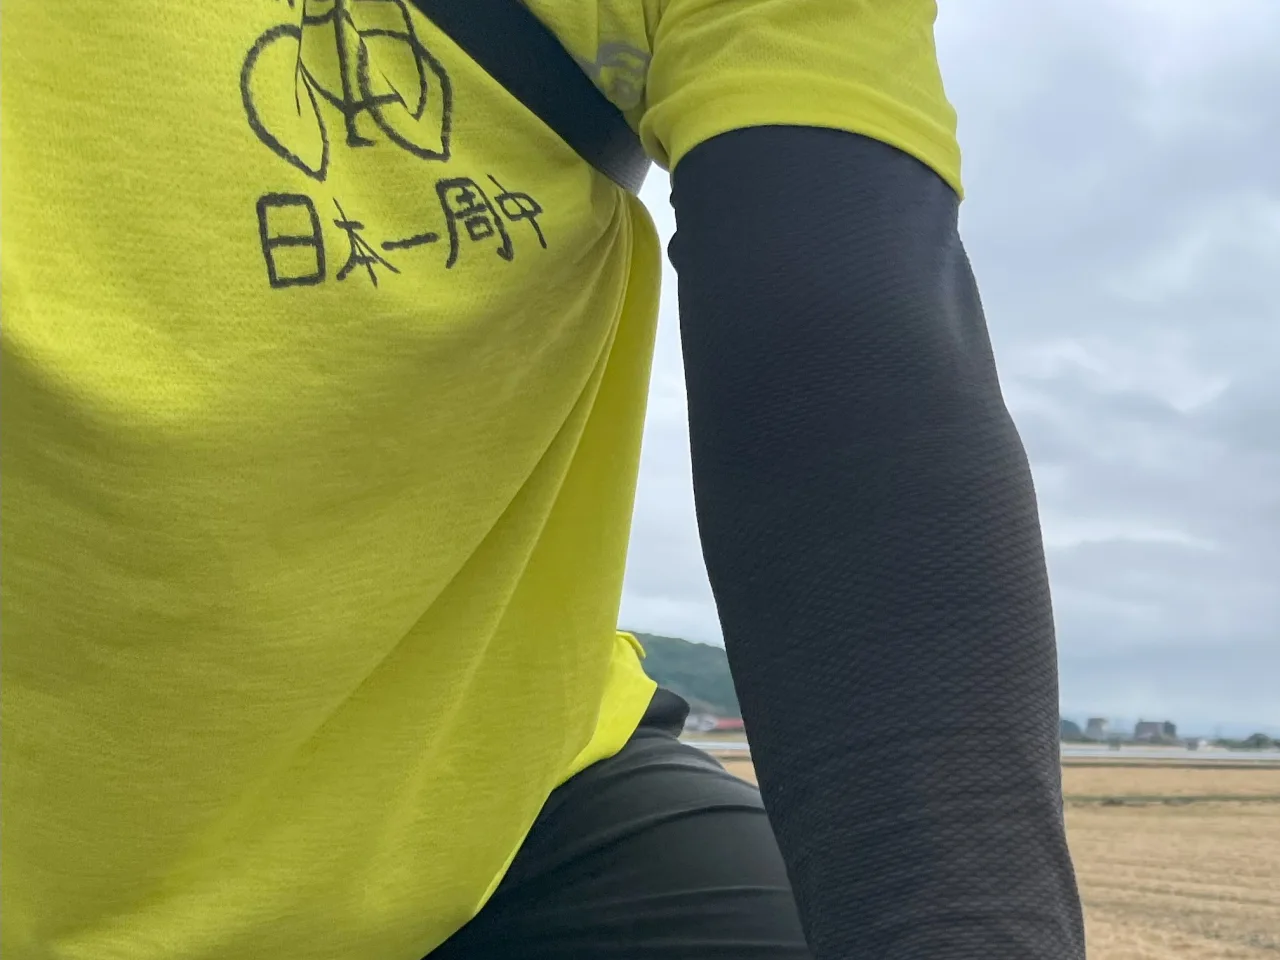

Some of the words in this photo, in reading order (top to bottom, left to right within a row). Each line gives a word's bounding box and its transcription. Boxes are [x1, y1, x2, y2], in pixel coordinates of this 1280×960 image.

[256, 174, 547, 289] 日本一周中
